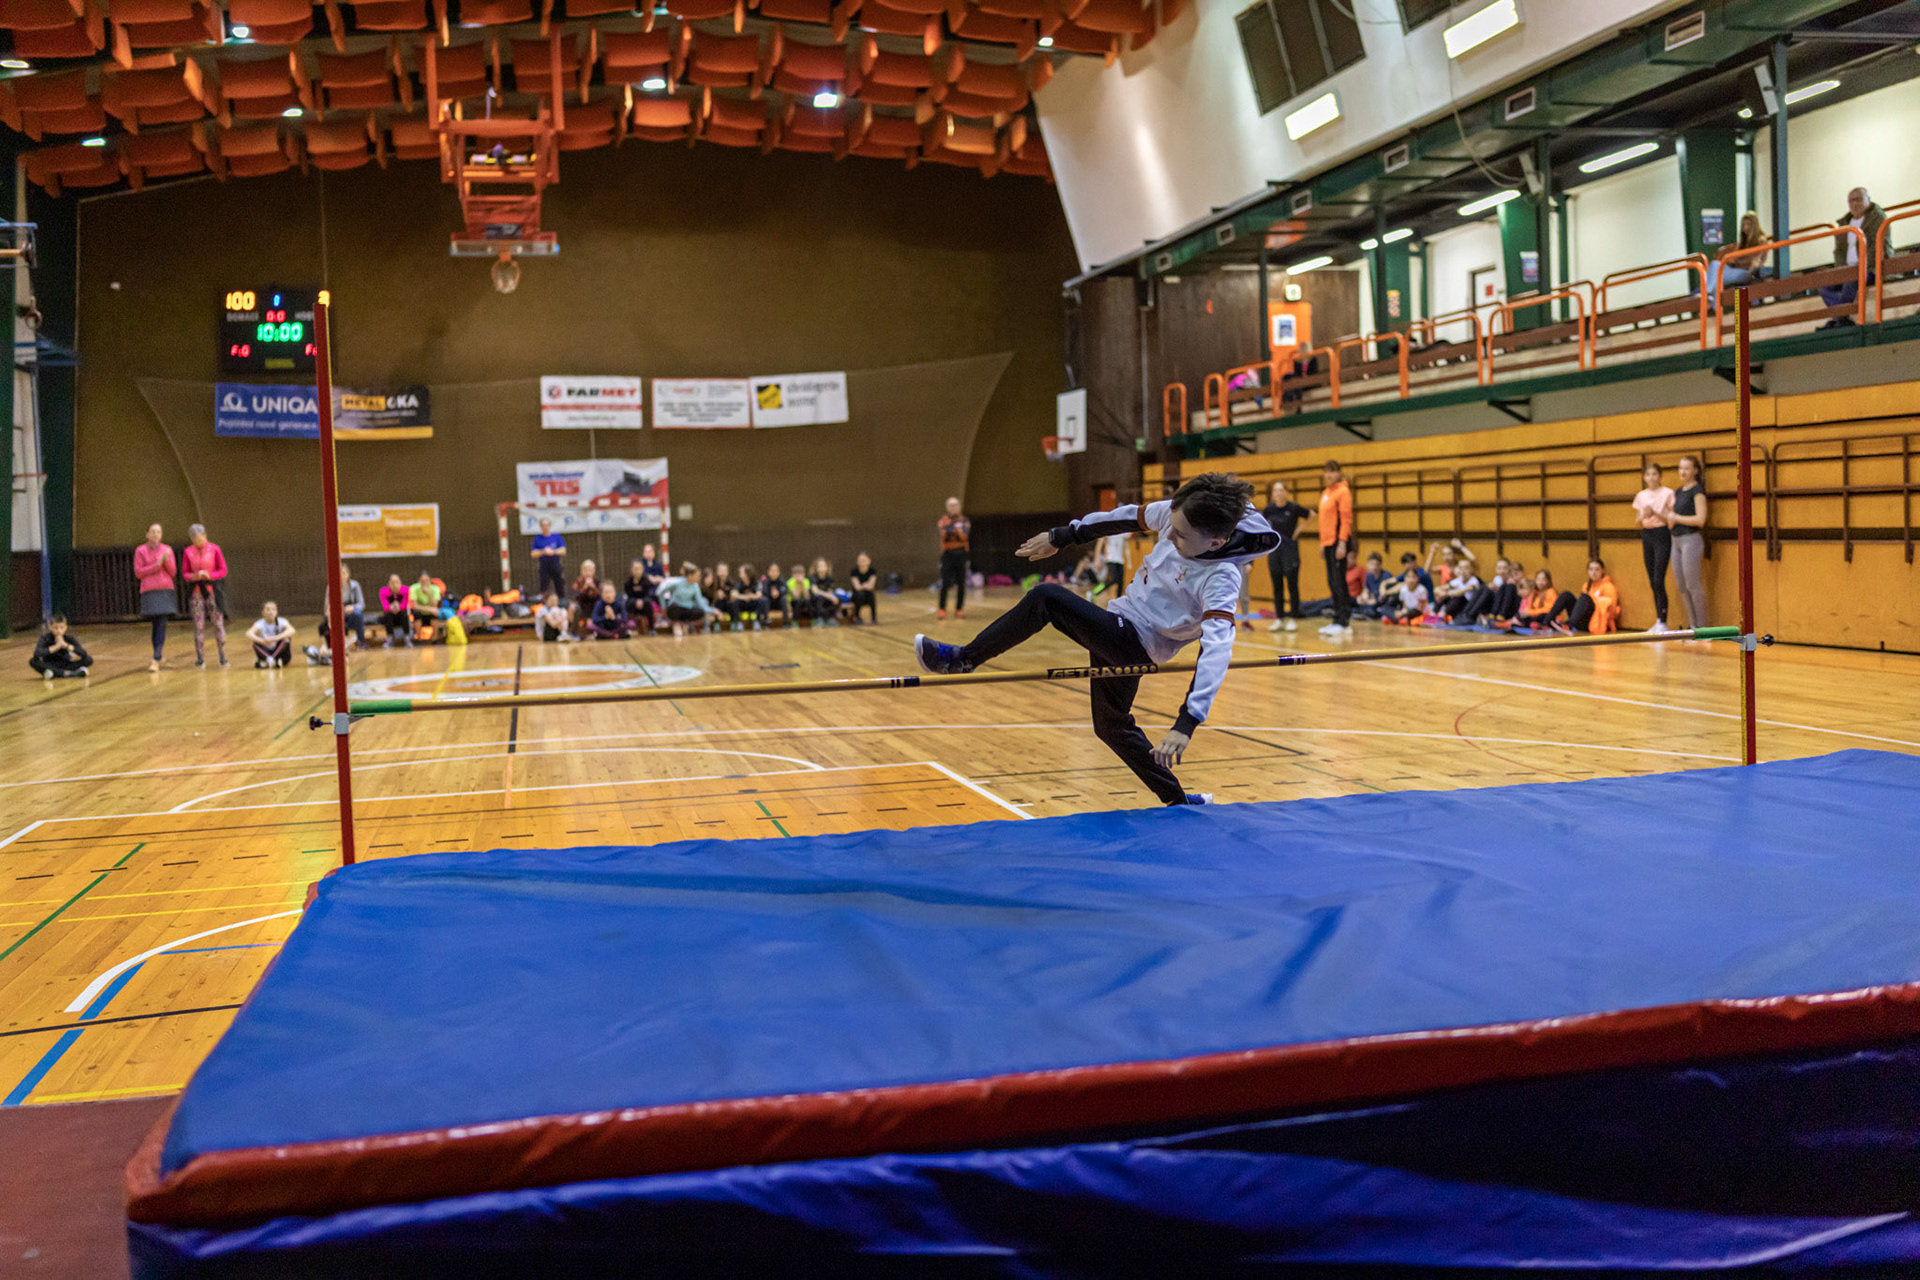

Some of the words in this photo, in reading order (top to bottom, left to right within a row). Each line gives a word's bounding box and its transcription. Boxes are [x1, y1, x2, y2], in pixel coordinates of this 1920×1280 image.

[226, 291, 255, 311] 100
[257, 322, 303, 342] 10:00
[252, 396, 319, 414] UNIQA
[1050, 666, 1115, 679] GETRA
